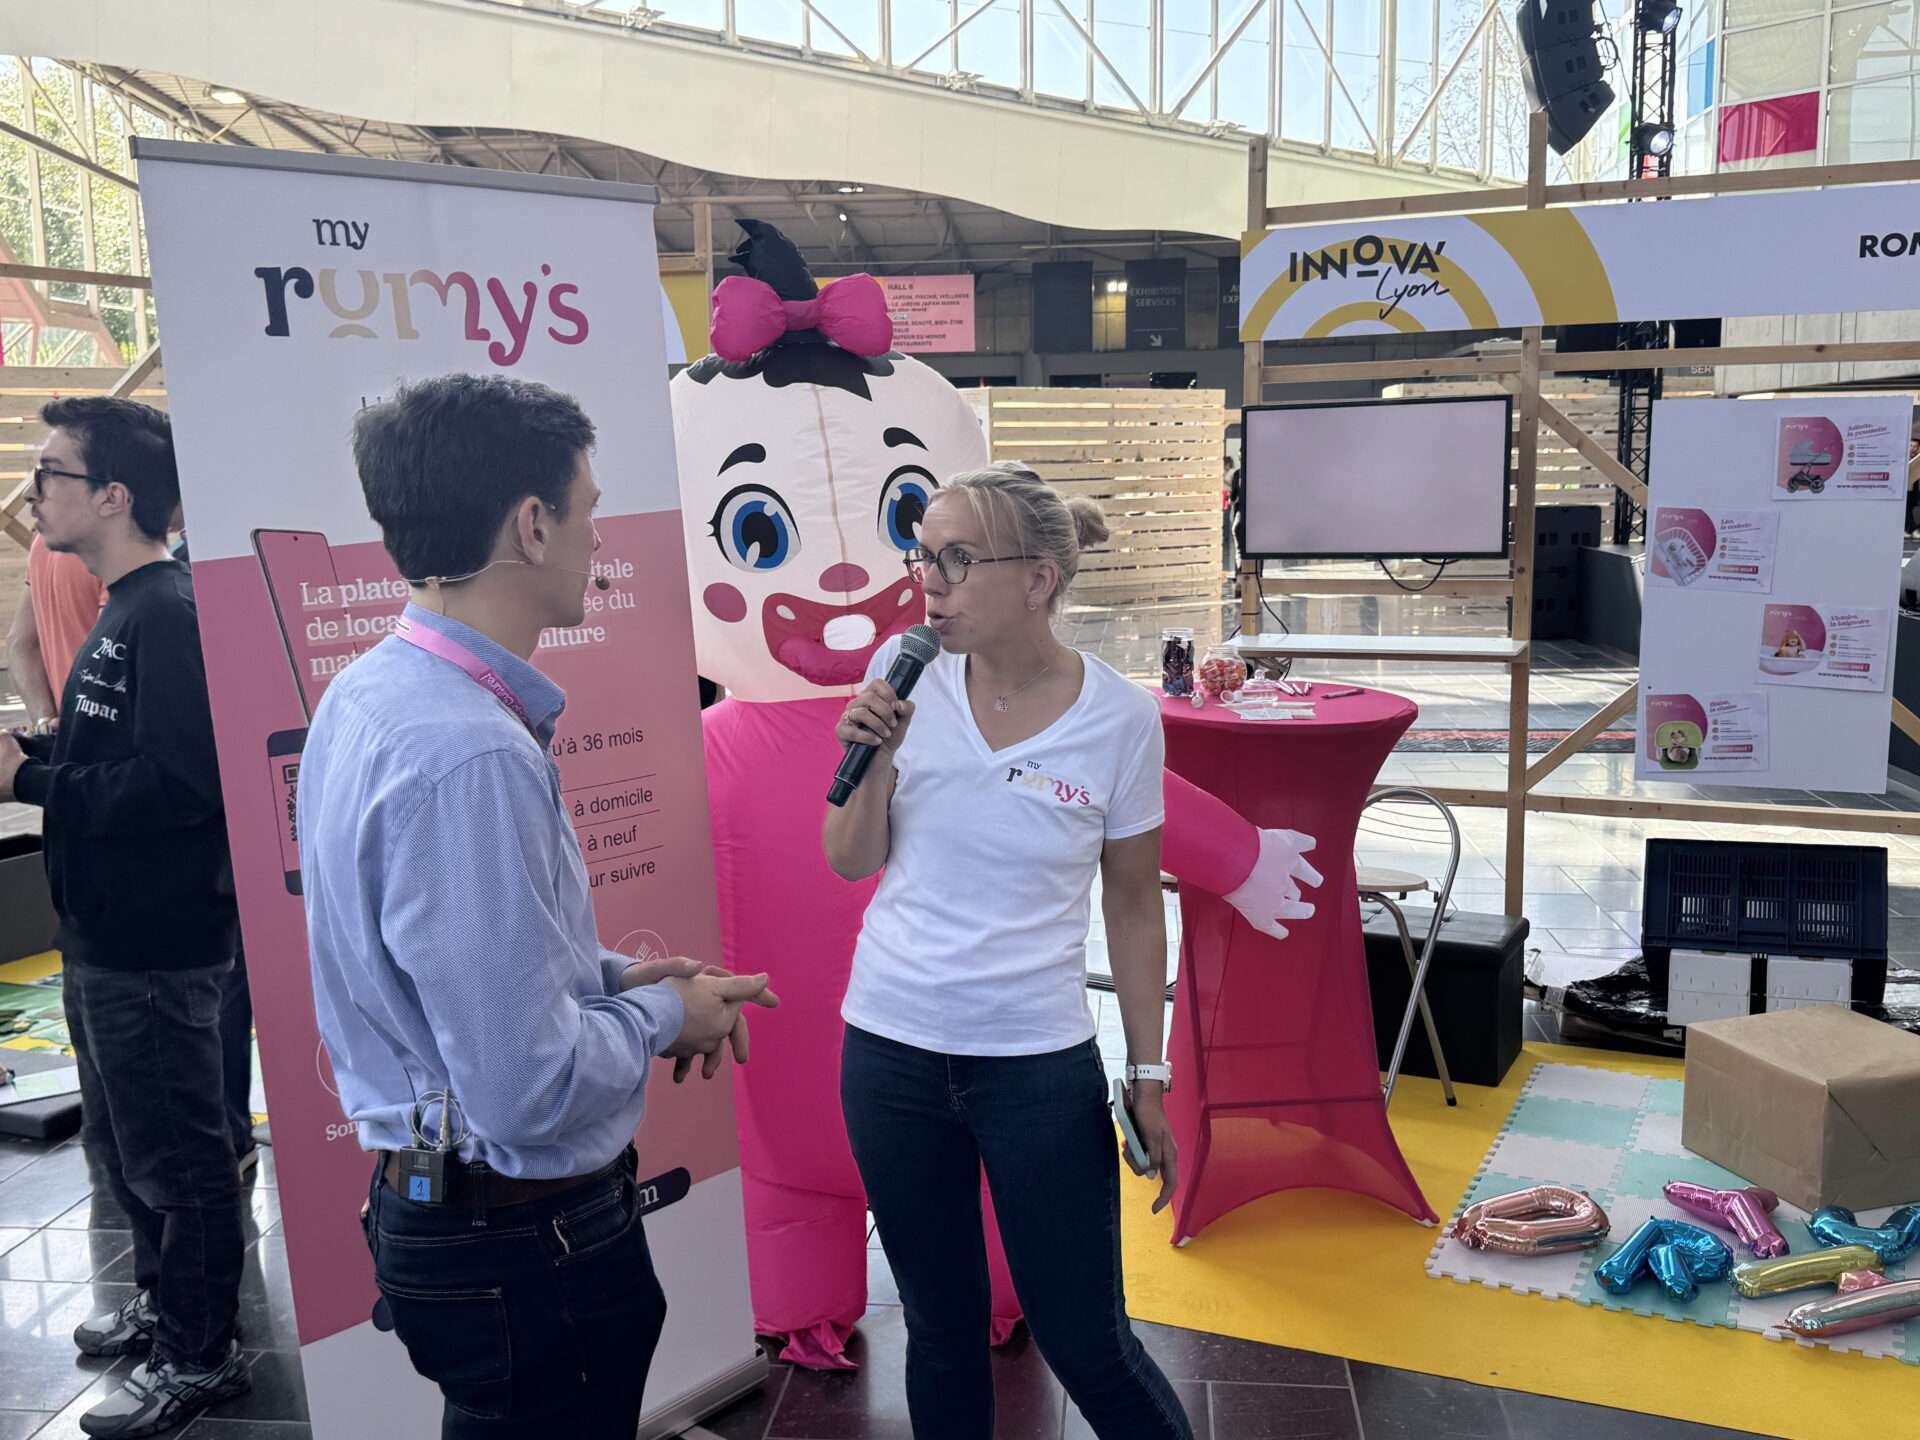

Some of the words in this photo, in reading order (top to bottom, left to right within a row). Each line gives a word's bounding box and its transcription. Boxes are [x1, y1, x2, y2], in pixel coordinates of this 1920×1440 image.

[312, 218, 369, 250] my
[1375, 265, 1450, 320] Lyon
[299, 582, 334, 605] La
[609, 589, 636, 609] du
[305, 617, 339, 641] de
[92, 637, 127, 660] 2PAC
[75, 694, 118, 721] Tupac
[582, 733, 604, 752] 36
[609, 728, 644, 748] mois
[1027, 760, 1042, 771] my
[574, 799, 585, 817] à
[590, 788, 654, 814] domicile
[587, 834, 598, 851] à
[603, 825, 638, 849] neuf
[610, 861, 656, 884] suivre
